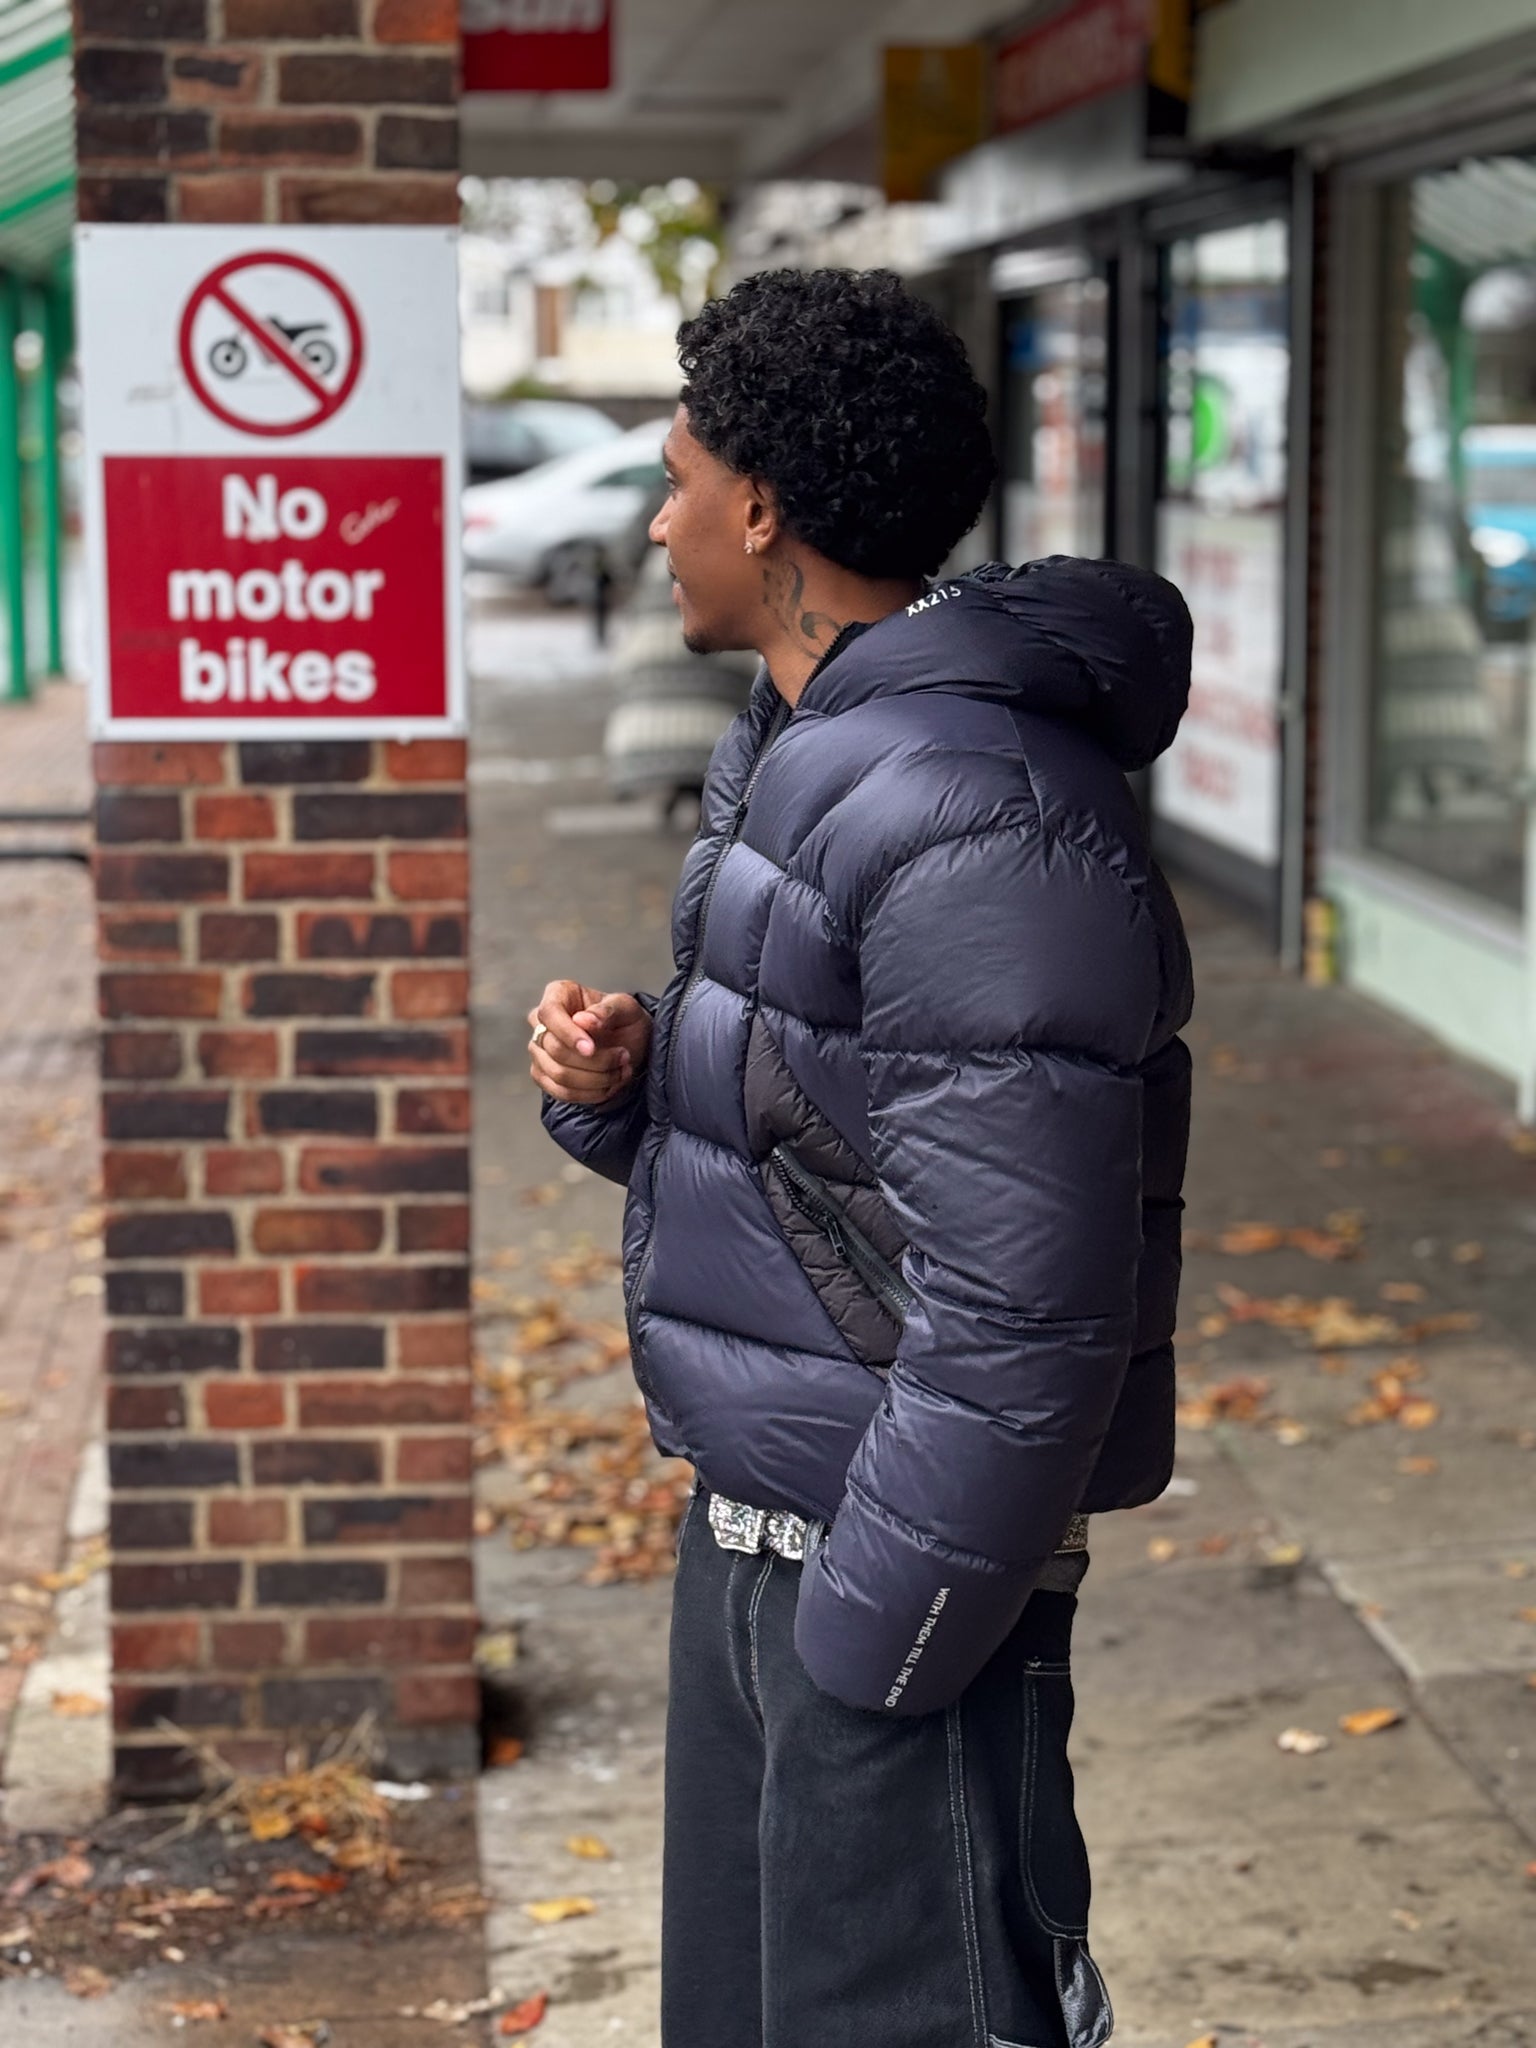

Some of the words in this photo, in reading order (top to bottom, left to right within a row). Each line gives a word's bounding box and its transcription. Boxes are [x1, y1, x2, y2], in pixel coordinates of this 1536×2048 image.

[221, 474, 328, 541] No
[168, 559, 385, 622] motor
[179, 636, 378, 703] bikes
[929, 1587, 951, 1615] WITH
[915, 1616, 938, 1645] THEM
[904, 1646, 923, 1664] TILL
[895, 1667, 914, 1686] THE
[884, 1685, 903, 1708] END
